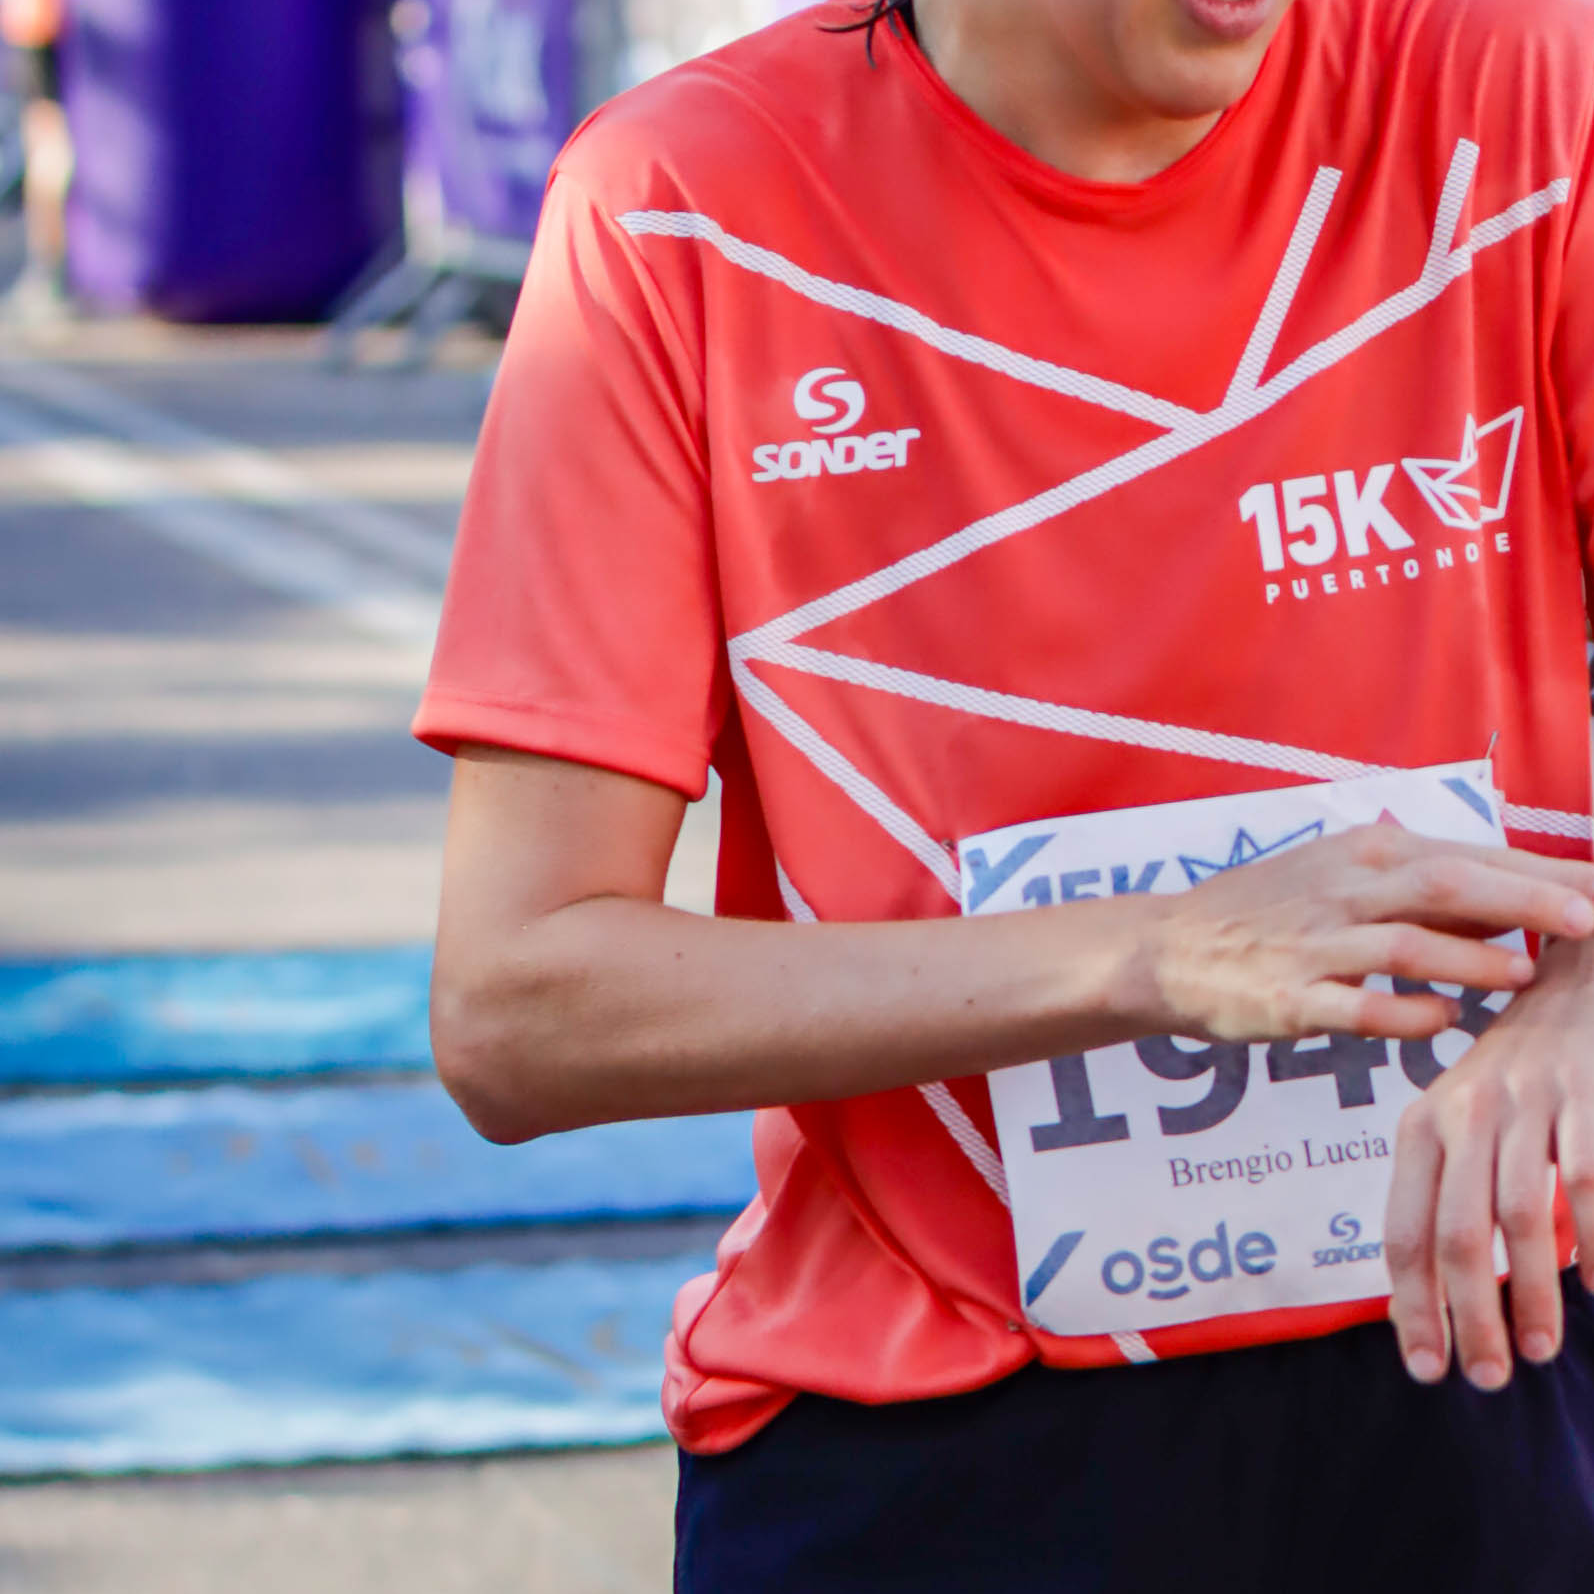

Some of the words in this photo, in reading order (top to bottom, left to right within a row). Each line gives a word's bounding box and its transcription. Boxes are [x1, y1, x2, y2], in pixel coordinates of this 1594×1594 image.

[1238, 462, 1416, 573] 15K
[1265, 557, 1420, 605] PUERTO
[1168, 1151, 1293, 1188] Brengio
[1303, 1133, 1389, 1168] Lucia
[1101, 1220, 1278, 1301] osde
